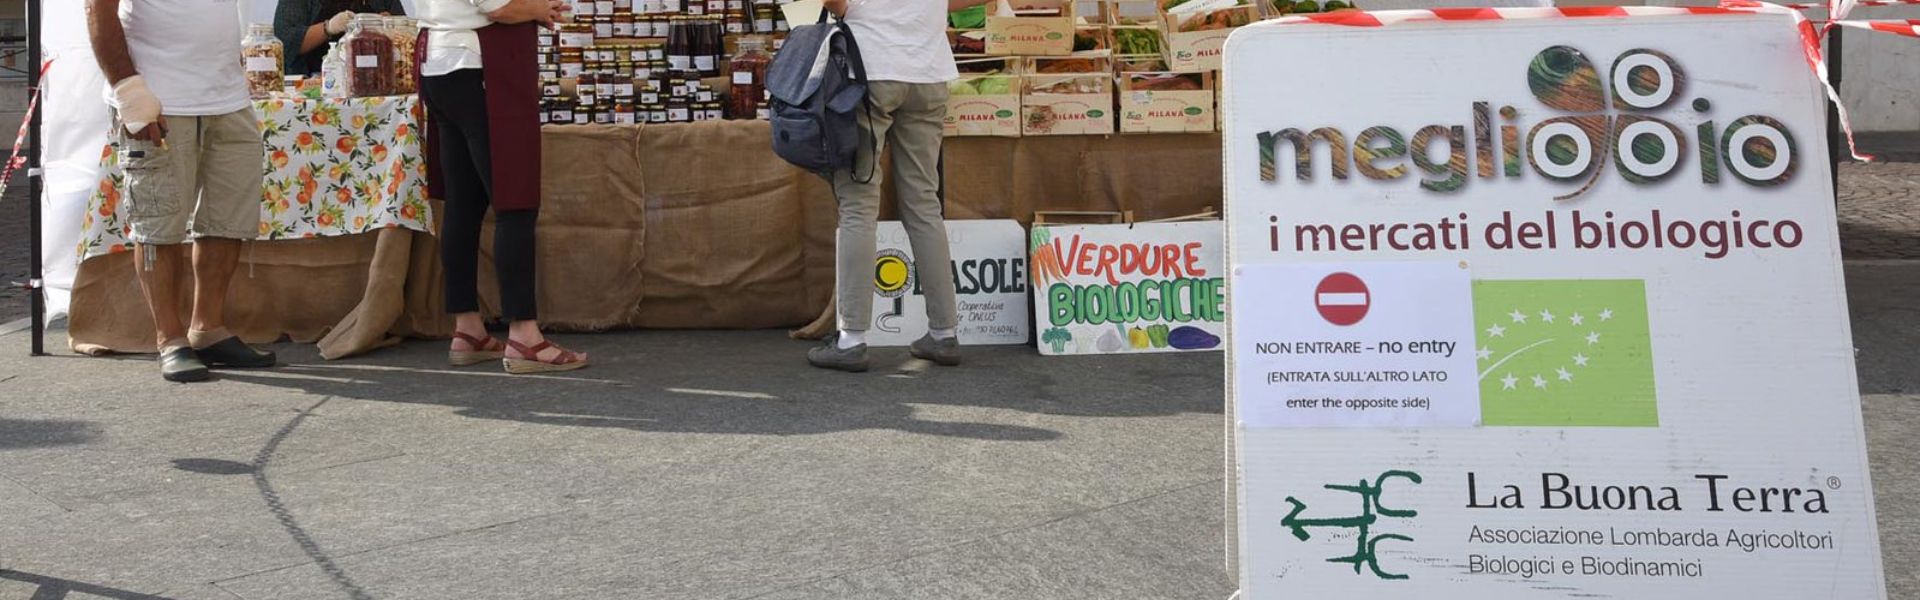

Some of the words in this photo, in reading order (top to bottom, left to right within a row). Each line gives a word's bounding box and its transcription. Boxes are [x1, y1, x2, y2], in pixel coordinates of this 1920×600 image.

[1197, 48, 1223, 57] MILA
[1269, 215, 1279, 252] i
[1295, 213, 1470, 252] mercati
[1484, 210, 1557, 250] del
[1571, 209, 1804, 260] biologico
[1055, 234, 1206, 286] VERDURE
[1048, 277, 1225, 327] BIOLOGICHE
[1256, 342, 1292, 355] NON
[1295, 341, 1361, 355] ENTRARE
[1378, 341, 1403, 354] no
[1407, 339, 1457, 358] entry
[1267, 372, 1331, 385] (ENTRATA
[1333, 370, 1410, 384] SULL'ALTRO
[1412, 370, 1448, 383] LATO
[1286, 398, 1319, 409] enter
[1321, 397, 1343, 409] the
[1345, 396, 1399, 411] opposite
[1401, 397, 1431, 411] side)
[1465, 471, 1525, 510] La
[1539, 472, 1683, 512] Buona
[1468, 524, 1604, 546] Associazione
[1610, 526, 1720, 549] Lombarda
[1725, 528, 1834, 553] Agricoltori
[1468, 554, 1555, 578] Biologici
[1561, 560, 1575, 575] e
[1581, 556, 1703, 578] Biodinamici
